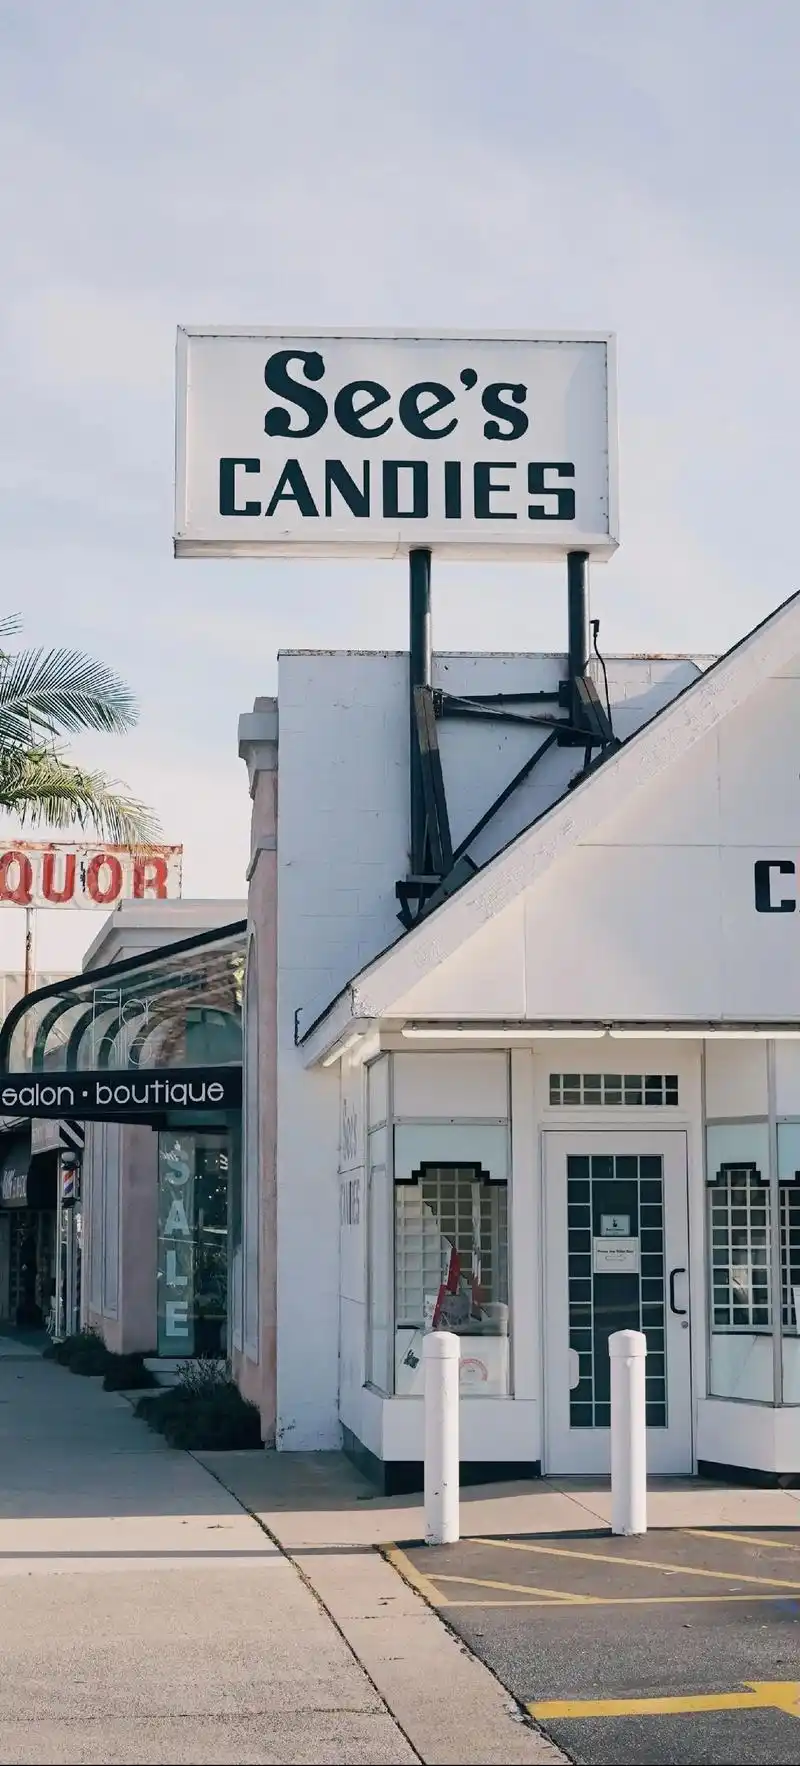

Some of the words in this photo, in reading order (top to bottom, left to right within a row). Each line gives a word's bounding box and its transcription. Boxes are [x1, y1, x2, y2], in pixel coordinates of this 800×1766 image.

[264, 350, 529, 441] See's
[219, 457, 576, 520] CANDIES
[1, 1083, 74, 1106] salon
[96, 1080, 225, 1105] boutique
